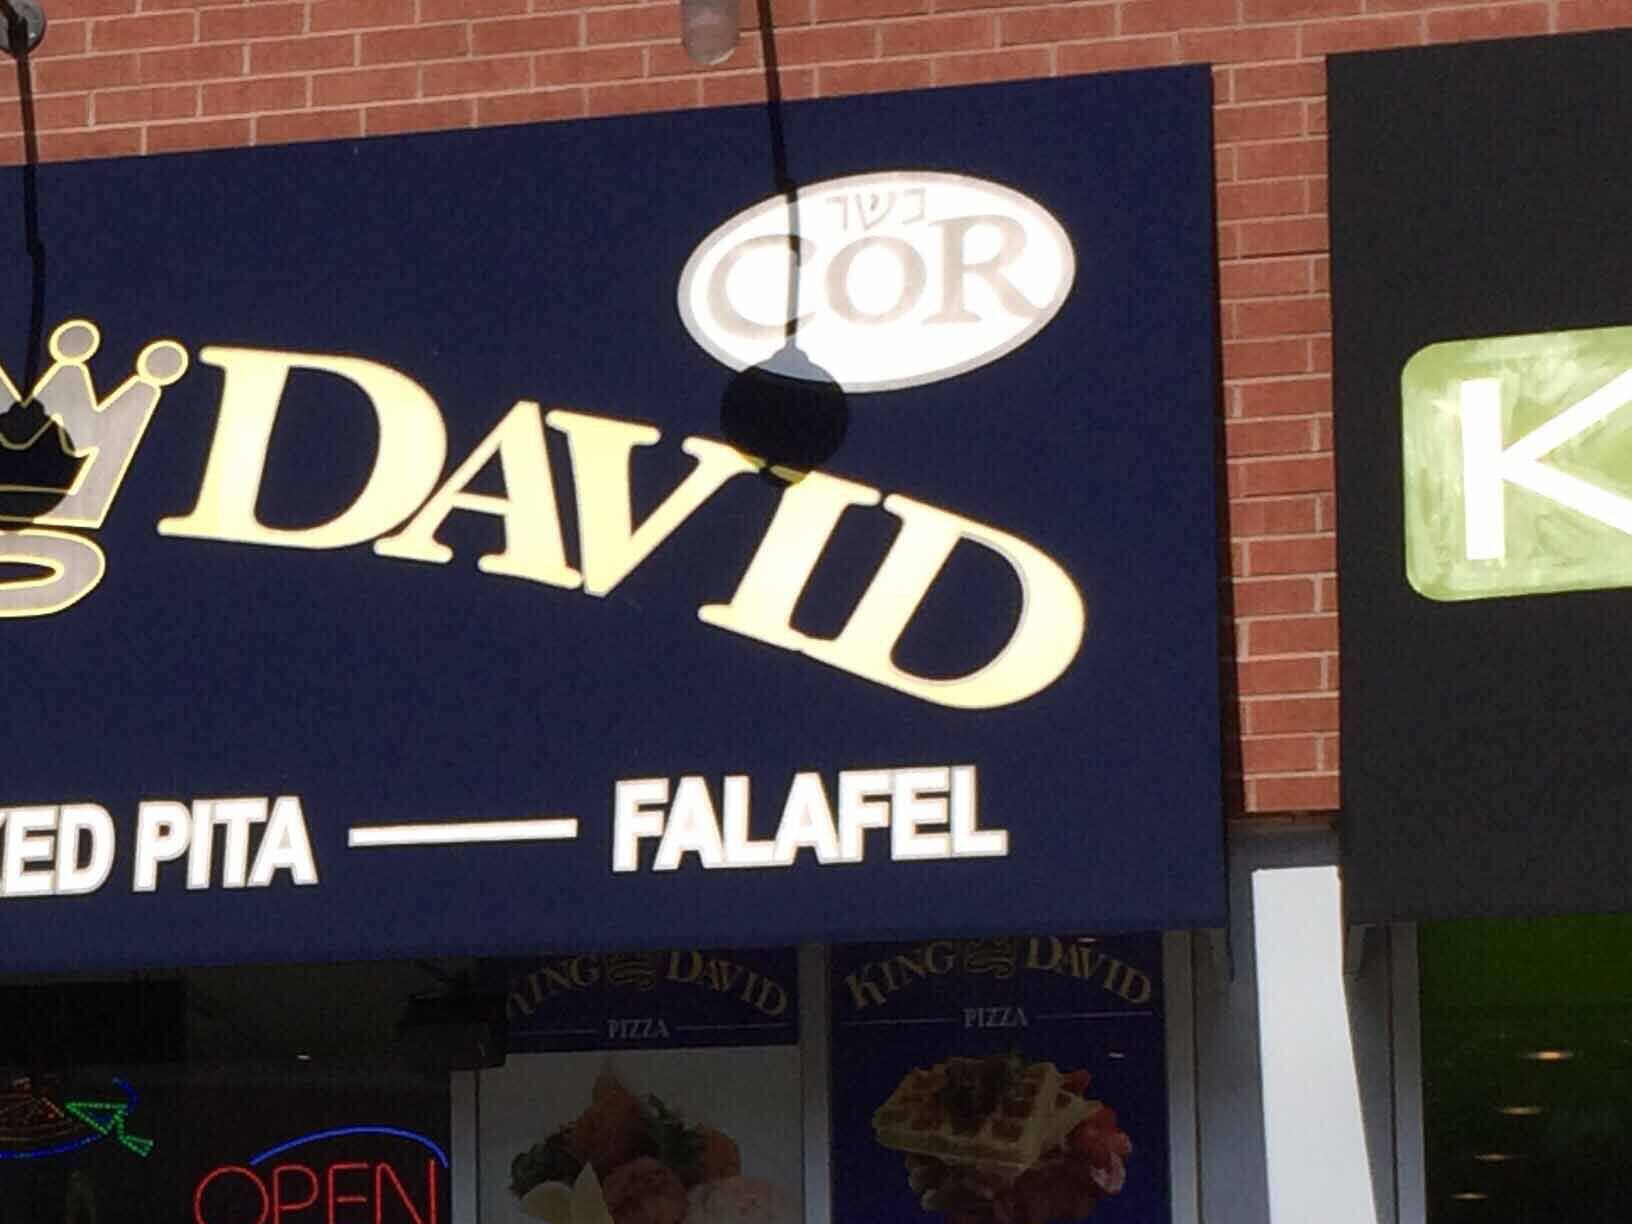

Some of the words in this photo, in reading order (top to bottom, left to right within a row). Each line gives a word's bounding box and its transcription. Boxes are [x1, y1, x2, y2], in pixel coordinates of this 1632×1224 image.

[707, 213, 1052, 340] COR
[157, 347, 1085, 710] DAVID
[133, 796, 317, 892] PITA
[613, 765, 1009, 872] FALAFEL
[664, 950, 788, 1018] DAVID
[844, 940, 956, 1010] KING
[1025, 935, 1153, 1005] DAVID
[607, 1018, 670, 1040] PIZZA
[963, 1007, 1030, 1030] PIZZA
